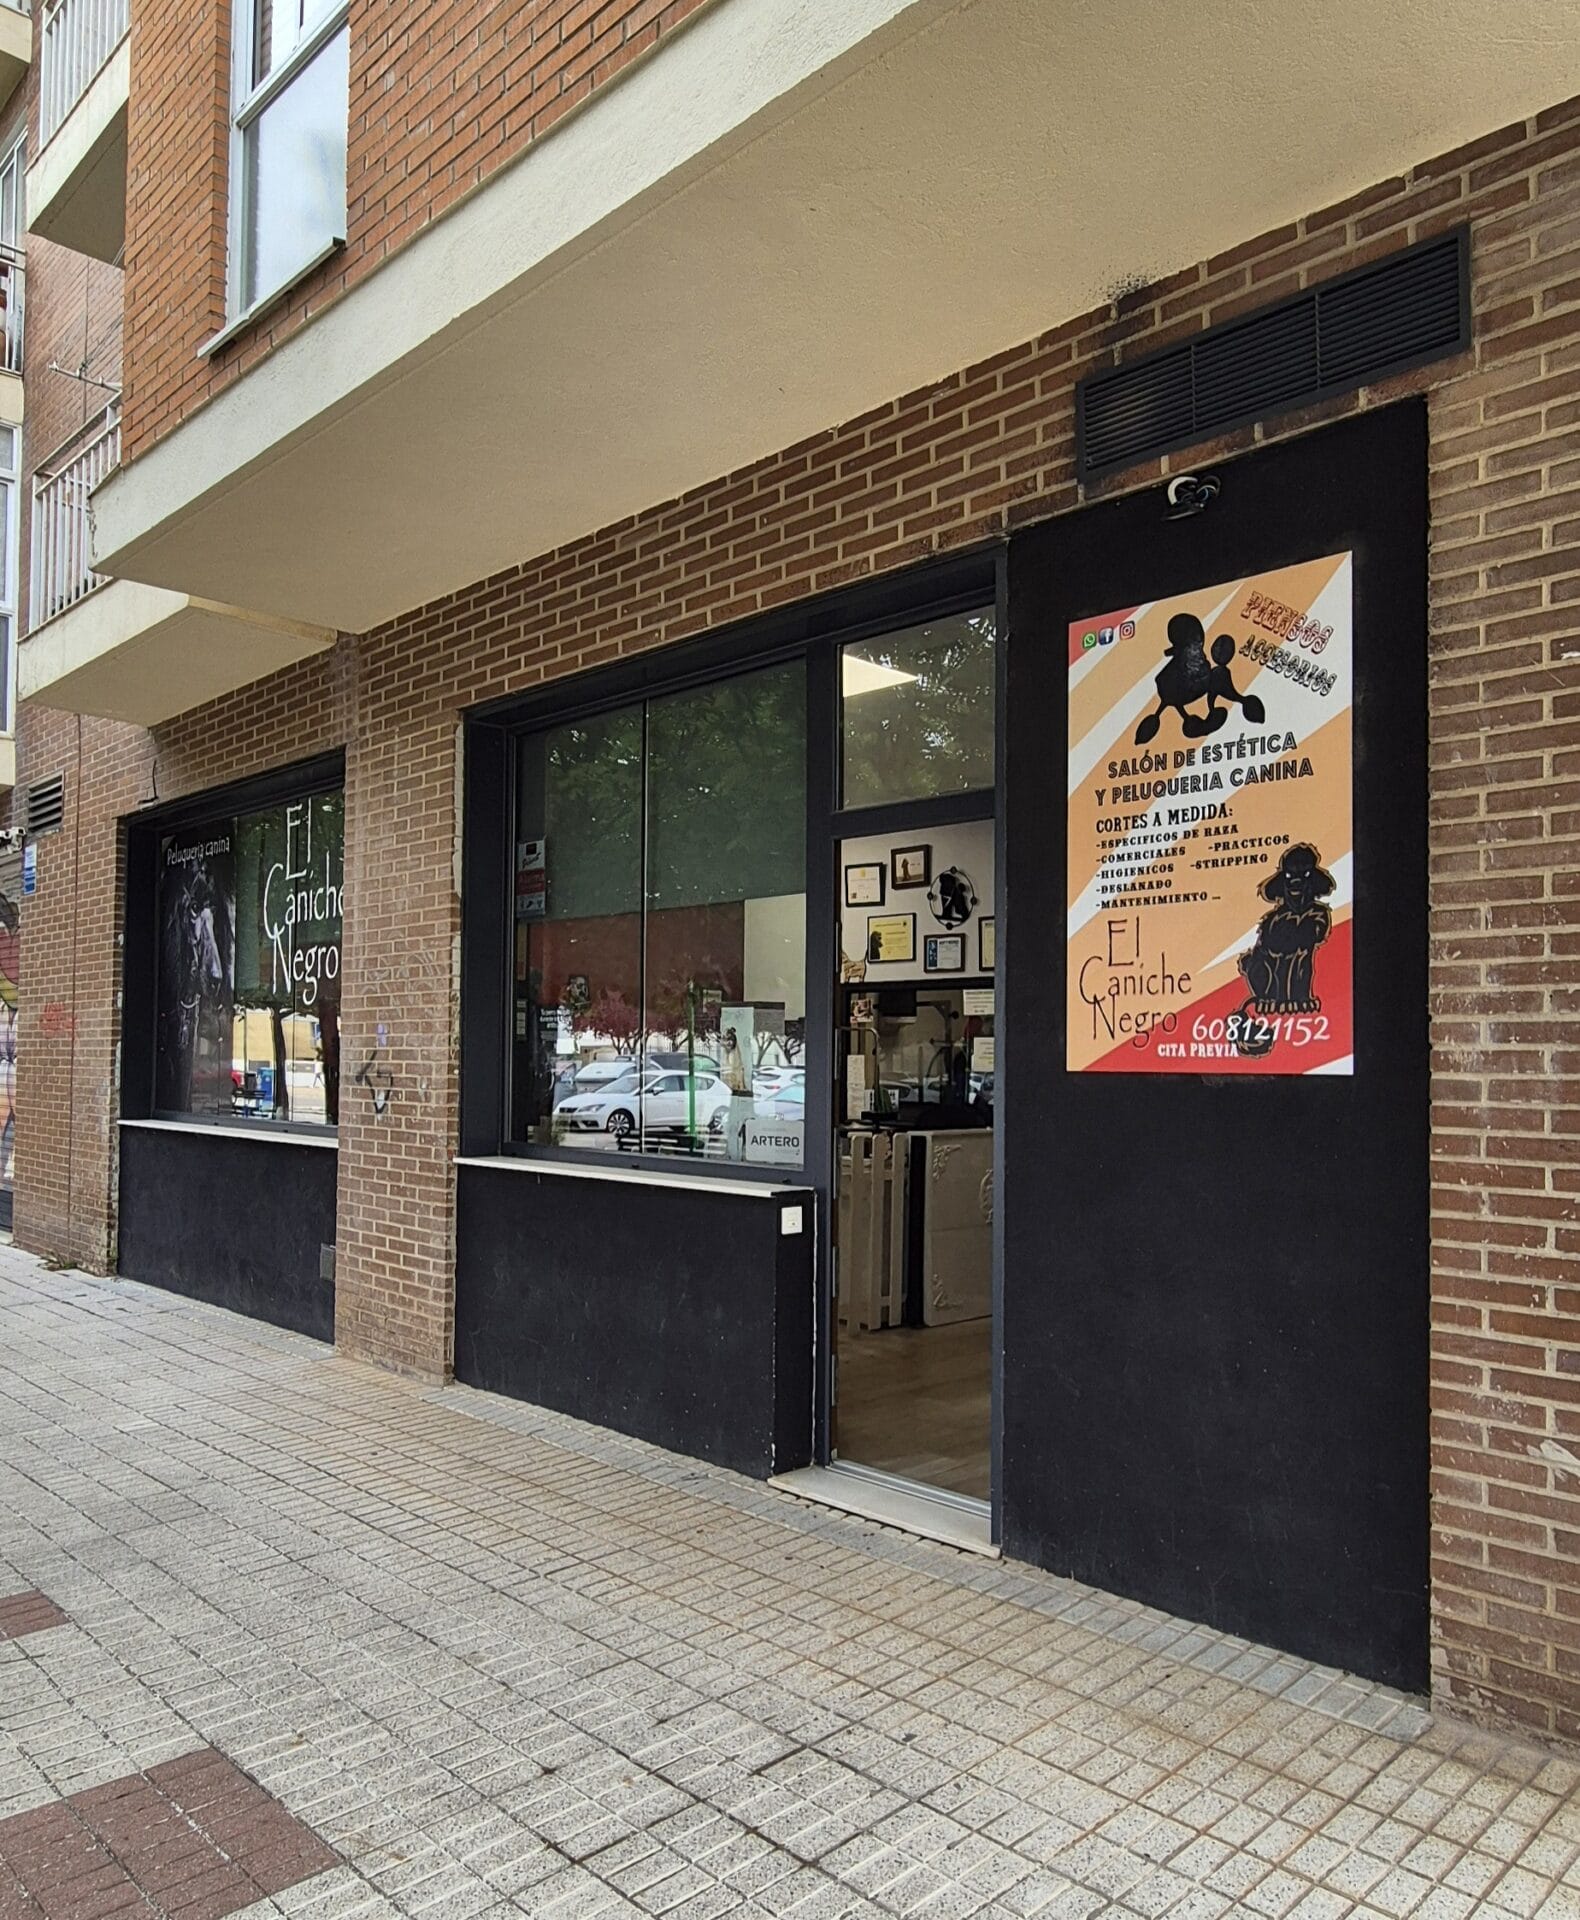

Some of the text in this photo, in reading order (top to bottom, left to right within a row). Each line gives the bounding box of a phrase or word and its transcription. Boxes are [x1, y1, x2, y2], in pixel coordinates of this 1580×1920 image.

[1241, 591, 1334, 654] PIENSOS
[1239, 634, 1337, 696] ACCESORIOS
[1108, 732, 1297, 779] SALÓN DE ESTÉTICA
[1095, 757, 1314, 806] Y PELUQUERIA CANINA
[285, 798, 311, 880] El
[1096, 803, 1233, 833] CORTES A MEDIDA:
[1183, 829, 1199, 840] DE
[1204, 824, 1239, 837] RAZA
[205, 836, 230, 857] canina
[273, 922, 339, 1005] Negro
[1107, 915, 1140, 967] El
[1079, 951, 1192, 1005] Caniche
[1093, 994, 1178, 1048] Negro
[1192, 1013, 1330, 1047] 608121152
[1157, 1042, 1239, 1058] CITA PREVIA
[751, 1135, 800, 1148] ARTERO
